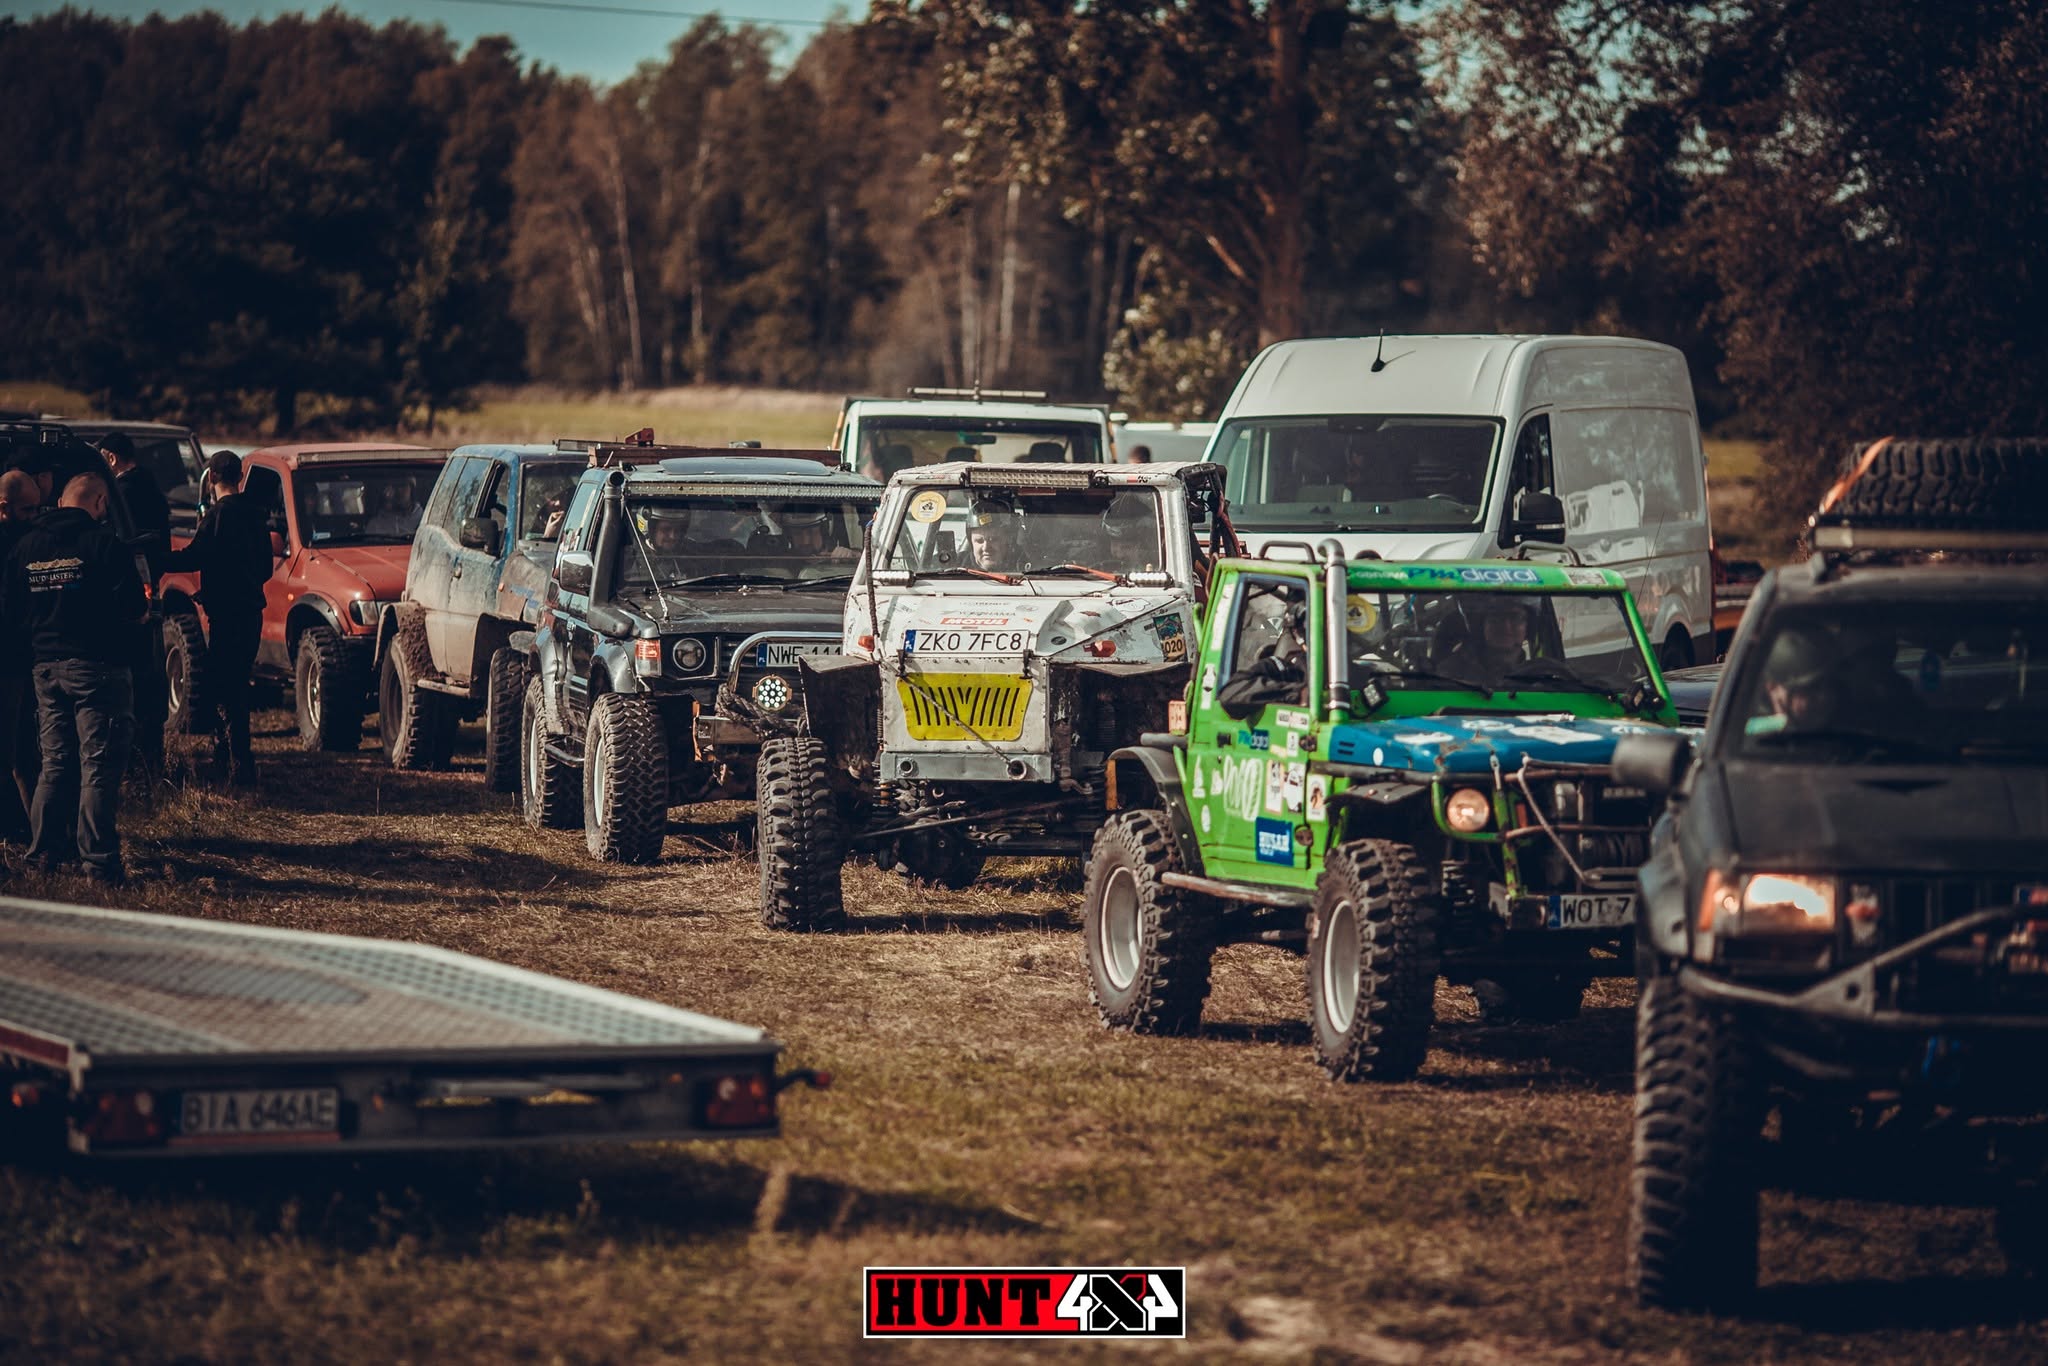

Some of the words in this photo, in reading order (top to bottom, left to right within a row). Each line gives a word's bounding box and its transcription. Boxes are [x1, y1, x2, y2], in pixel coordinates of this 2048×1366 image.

[1459, 566, 1538, 585] digital
[918, 632, 961, 651] ZKO
[967, 632, 1022, 651] 7FC8
[768, 646, 803, 664] NWE
[1563, 897, 1608, 923] WOT
[184, 1094, 239, 1129] BIA
